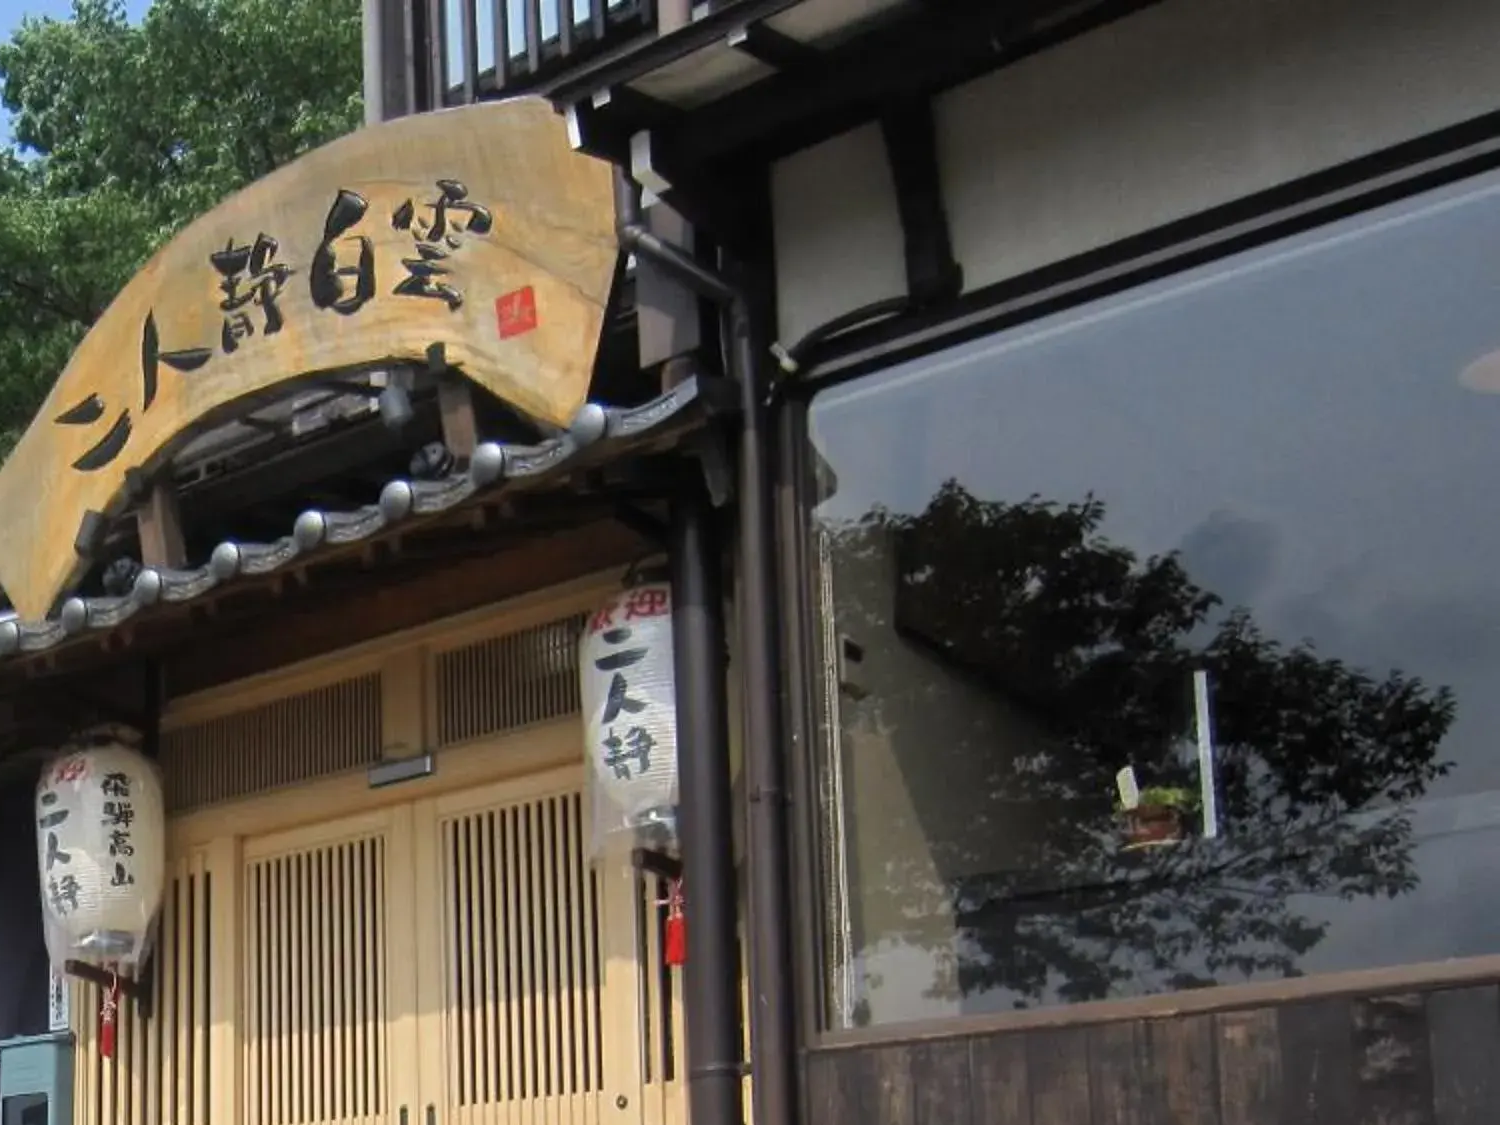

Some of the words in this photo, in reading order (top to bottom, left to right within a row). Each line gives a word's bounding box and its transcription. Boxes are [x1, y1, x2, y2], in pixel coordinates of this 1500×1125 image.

[594, 627, 657, 780] 二人静
[39, 790, 82, 917] 二人静
